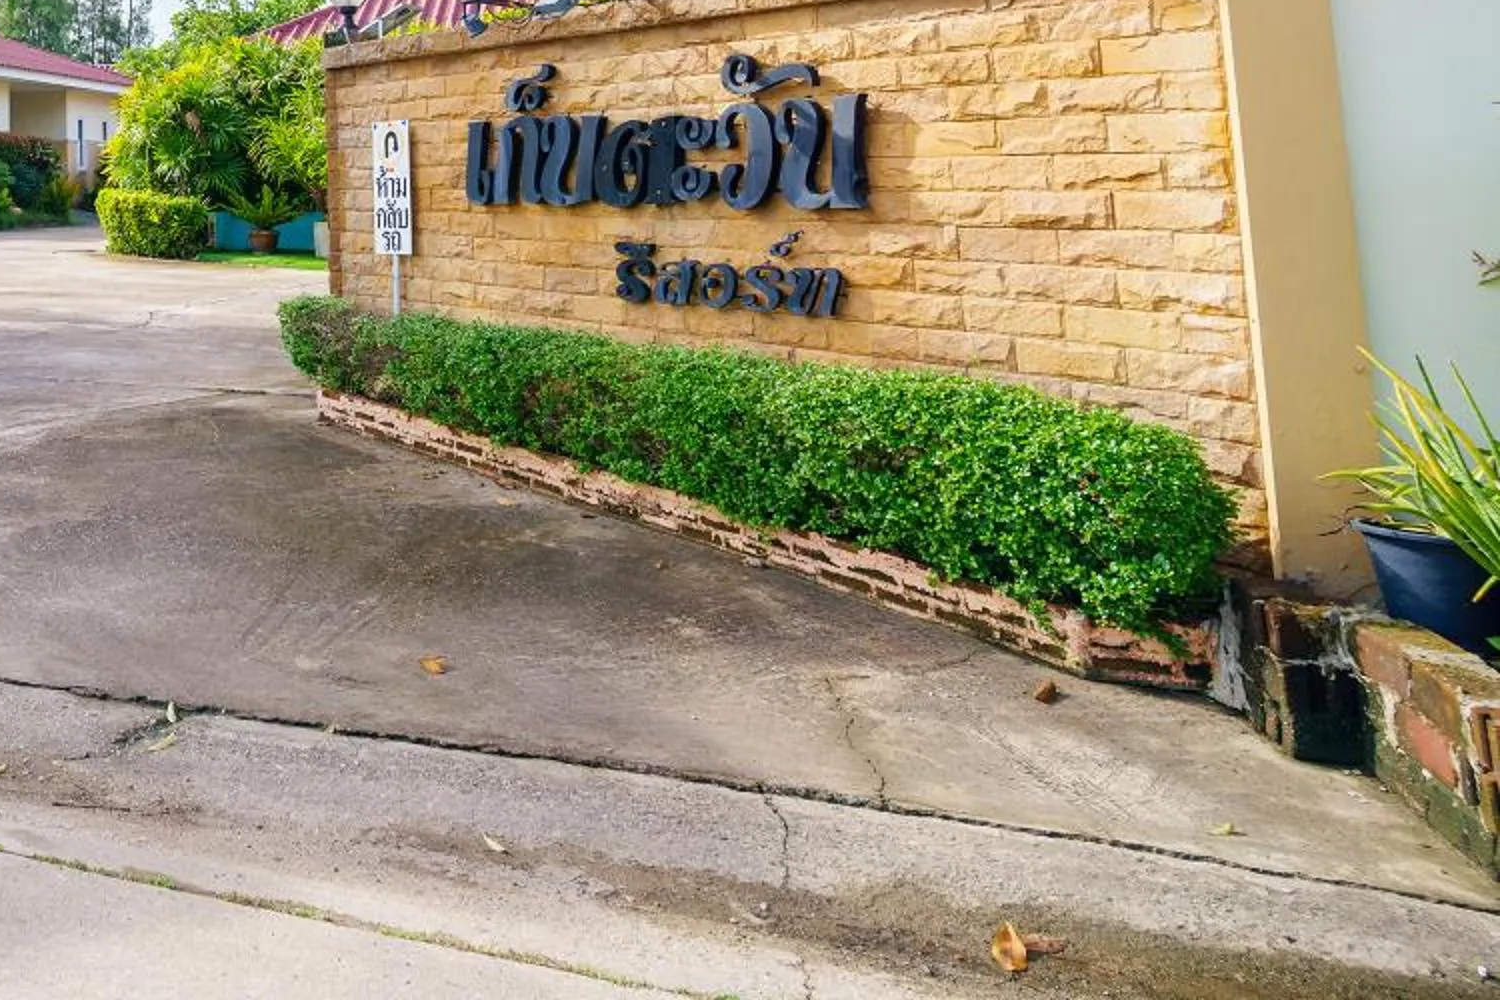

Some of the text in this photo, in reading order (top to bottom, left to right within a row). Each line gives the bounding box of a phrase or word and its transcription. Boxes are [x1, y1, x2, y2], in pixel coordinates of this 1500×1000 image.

[465, 55, 869, 210] เก็บตะวัน
[376, 165, 408, 198] ห้าม
[376, 200, 409, 229] กลับ
[381, 231, 402, 251] รถ
